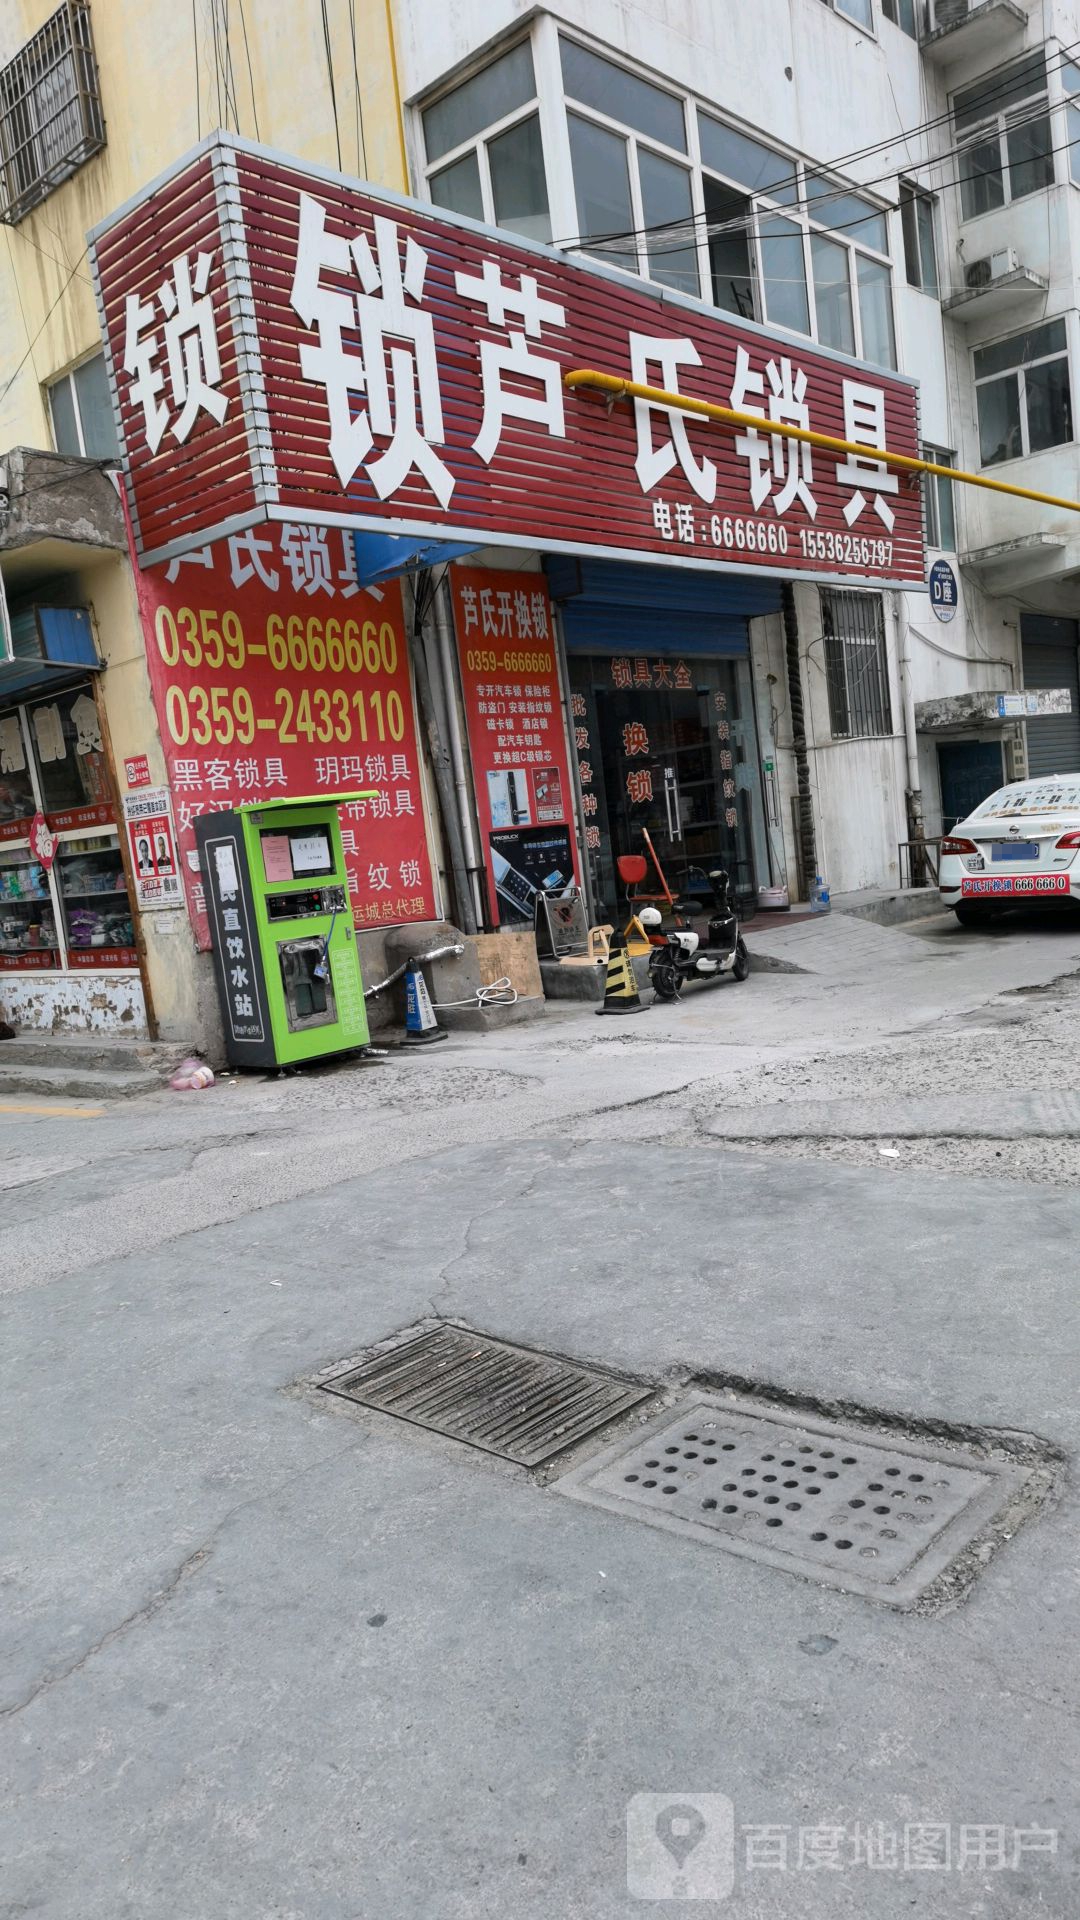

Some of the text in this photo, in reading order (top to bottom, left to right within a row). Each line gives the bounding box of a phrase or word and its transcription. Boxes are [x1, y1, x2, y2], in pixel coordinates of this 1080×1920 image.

[122, 251, 231, 456] 锁
[799, 528, 894, 567] 15536256797
[460, 585, 549, 640] 芦氏开换锁
[154, 604, 398, 675] 0359-6666660
[466, 649, 552, 673] 0359-6666660
[610, 657, 693, 689] 锁具大全
[478, 701, 506, 714] 防盗门
[524, 684, 551, 697] 保险柜
[165, 684, 405, 746] 0359-2433110
[521, 717, 549, 730] 酒店锁
[497, 734, 542, 747] 配汽车钥匙
[173, 753, 412, 792] 黑客锁具 玥玛锁具
[570, 693, 601, 849] 批发各种锁
[622, 721, 654, 804] 换锁
[352, 896, 427, 923] 运城总代理
